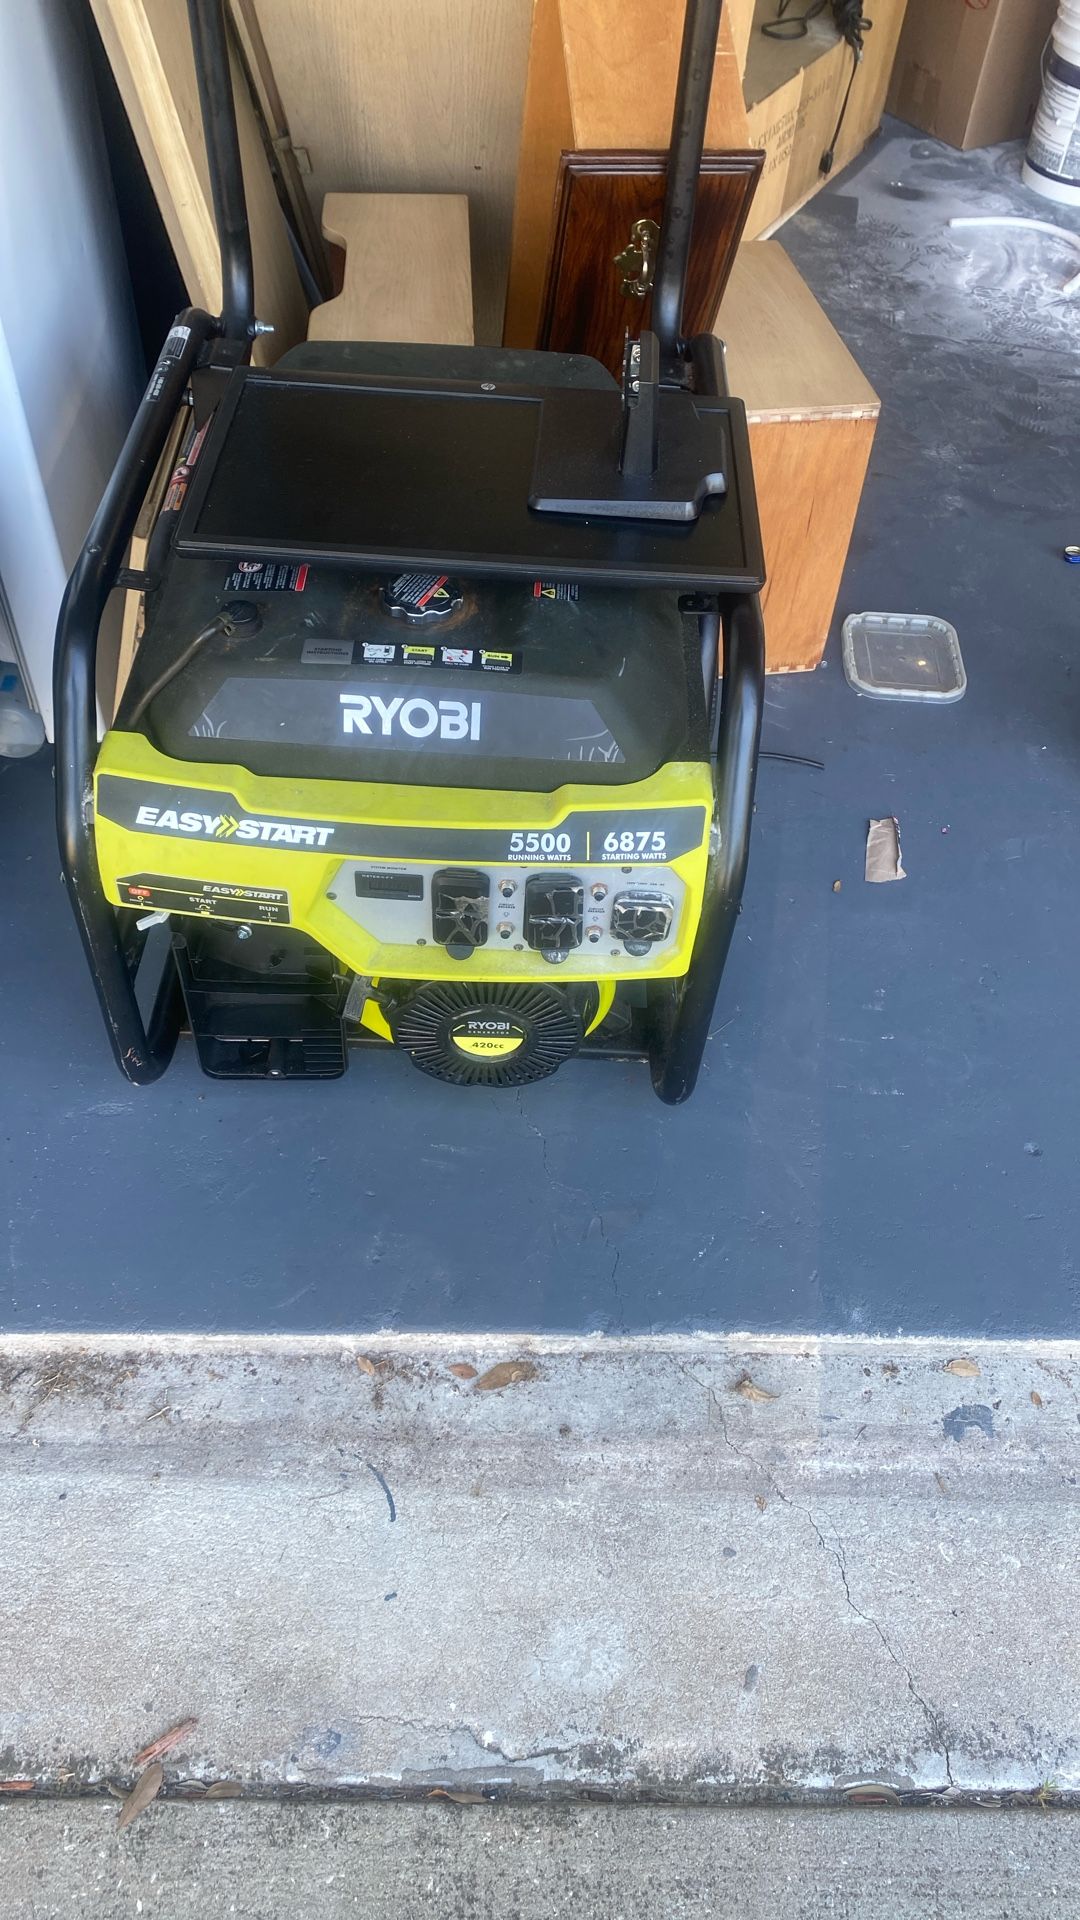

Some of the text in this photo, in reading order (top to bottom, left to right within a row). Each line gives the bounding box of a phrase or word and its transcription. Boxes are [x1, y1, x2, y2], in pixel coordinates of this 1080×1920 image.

[339, 693, 481, 741] RYOBI
[135, 805, 335, 846] EASY START
[509, 832, 571, 853] 5500
[603, 831, 666, 852] 6875
[507, 854, 572, 862] RUNNING WATTS
[601, 852, 667, 861] STARTING WATTS
[202, 885, 284, 900] EASY START
[189, 896, 217, 905] START
[468, 1021, 510, 1030] RYOBI
